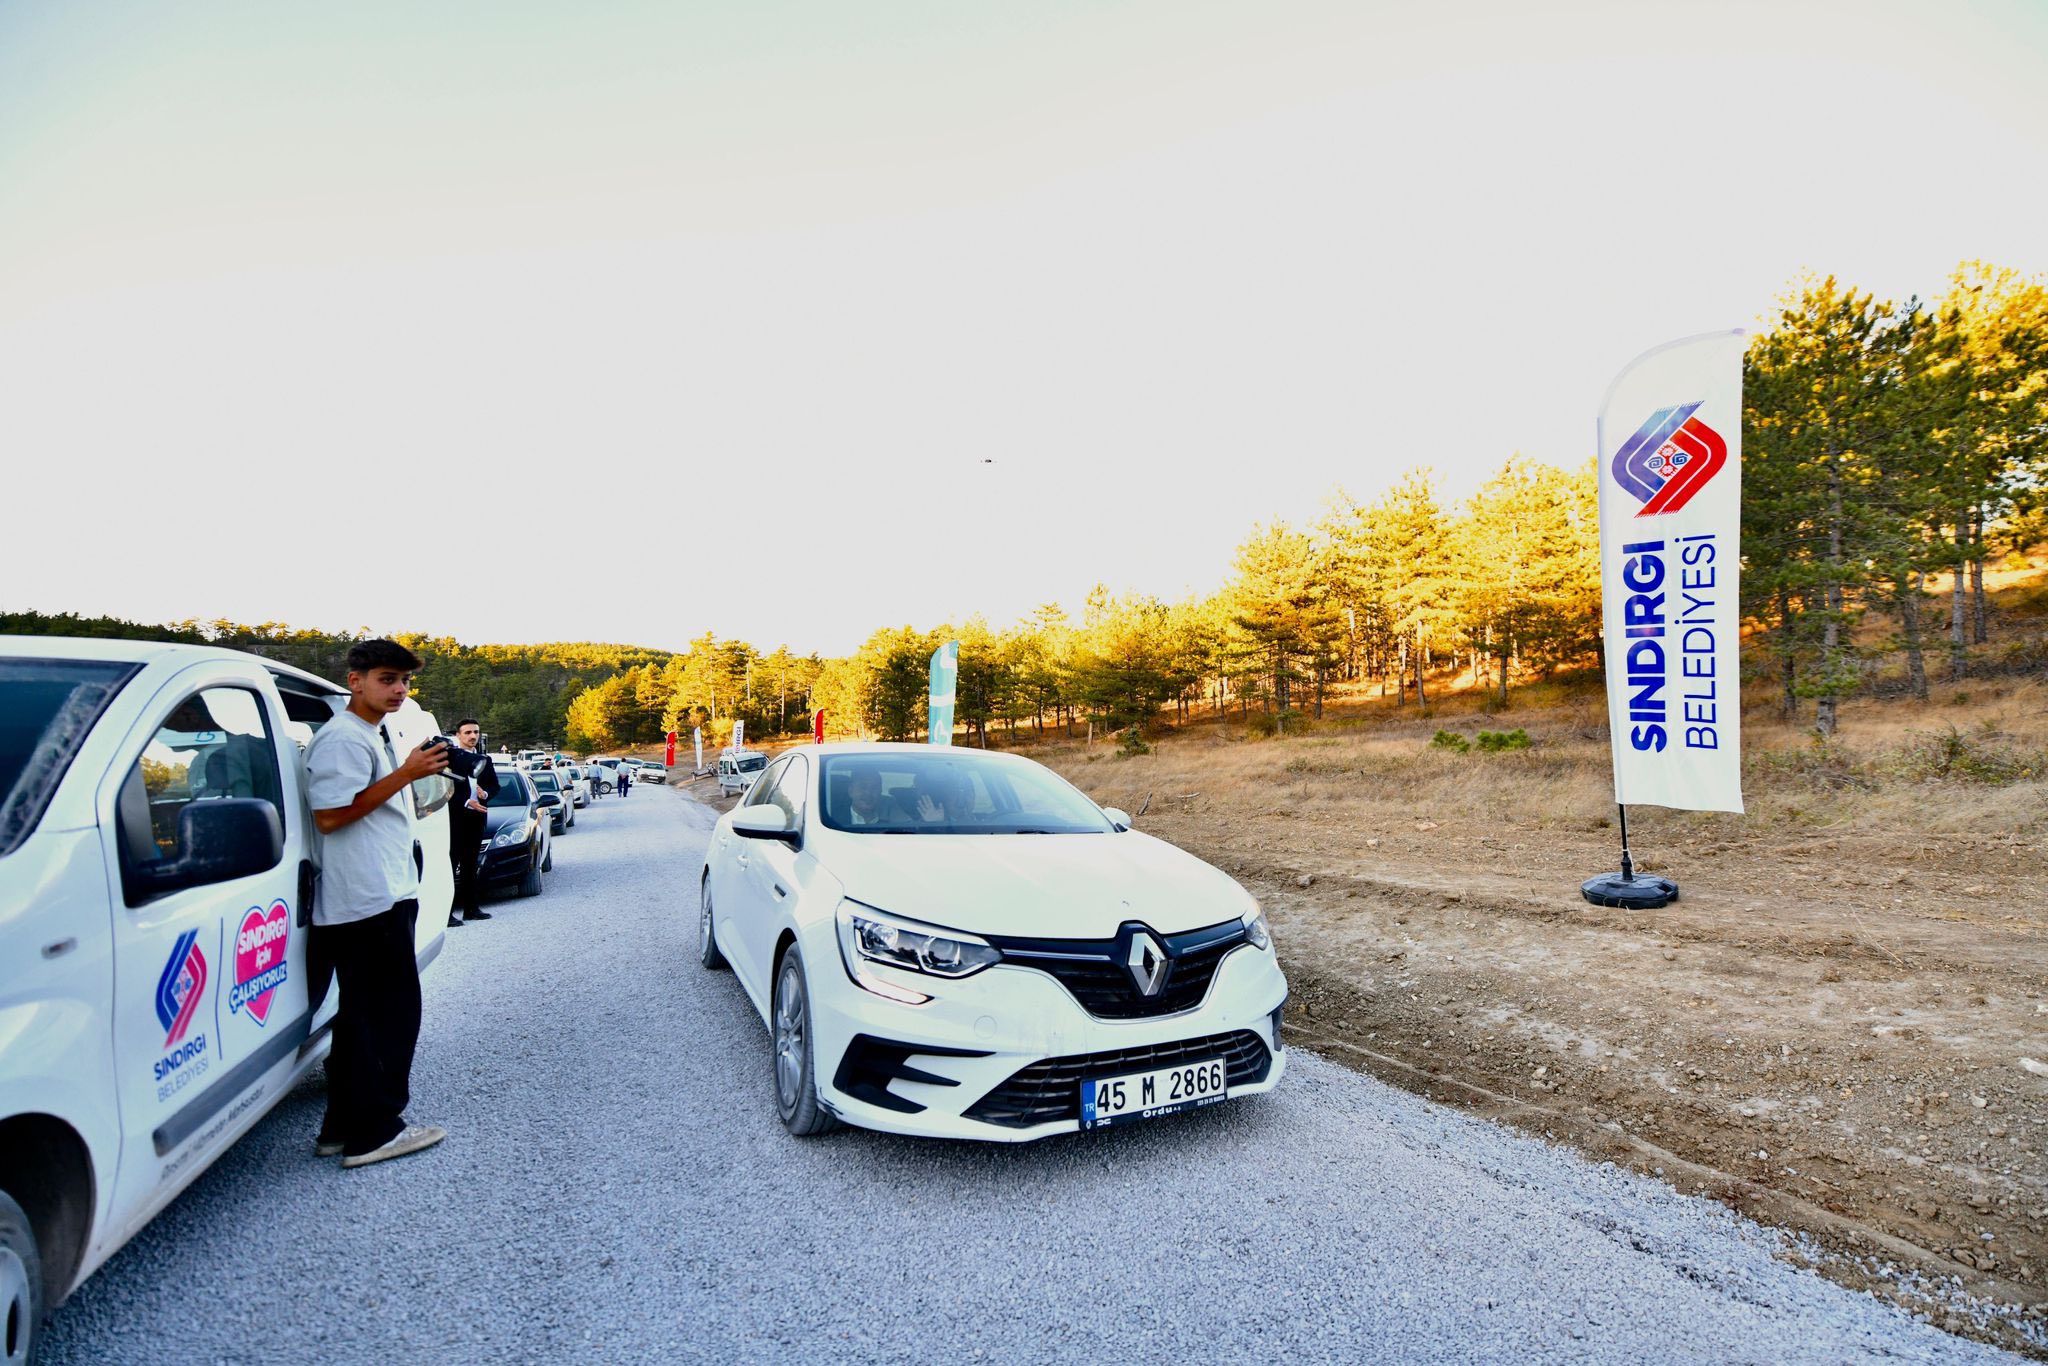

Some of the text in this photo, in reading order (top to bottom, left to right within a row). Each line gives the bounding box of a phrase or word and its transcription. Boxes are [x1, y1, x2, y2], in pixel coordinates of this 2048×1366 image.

[1623, 540, 1668, 753] SINDIRGI
[1674, 534, 1718, 750] BELEDİYESİ
[239, 916, 287, 955] SINDIRGI
[255, 946, 272, 970] için
[230, 963, 287, 1012] ÇALIŞIYORUZ
[153, 1033, 206, 1082] SINDIRGI
[1085, 1103, 1095, 1113] TR
[1097, 1063, 1222, 1113] 45 M 2866
[1142, 1106, 1173, 1118] Ordu
